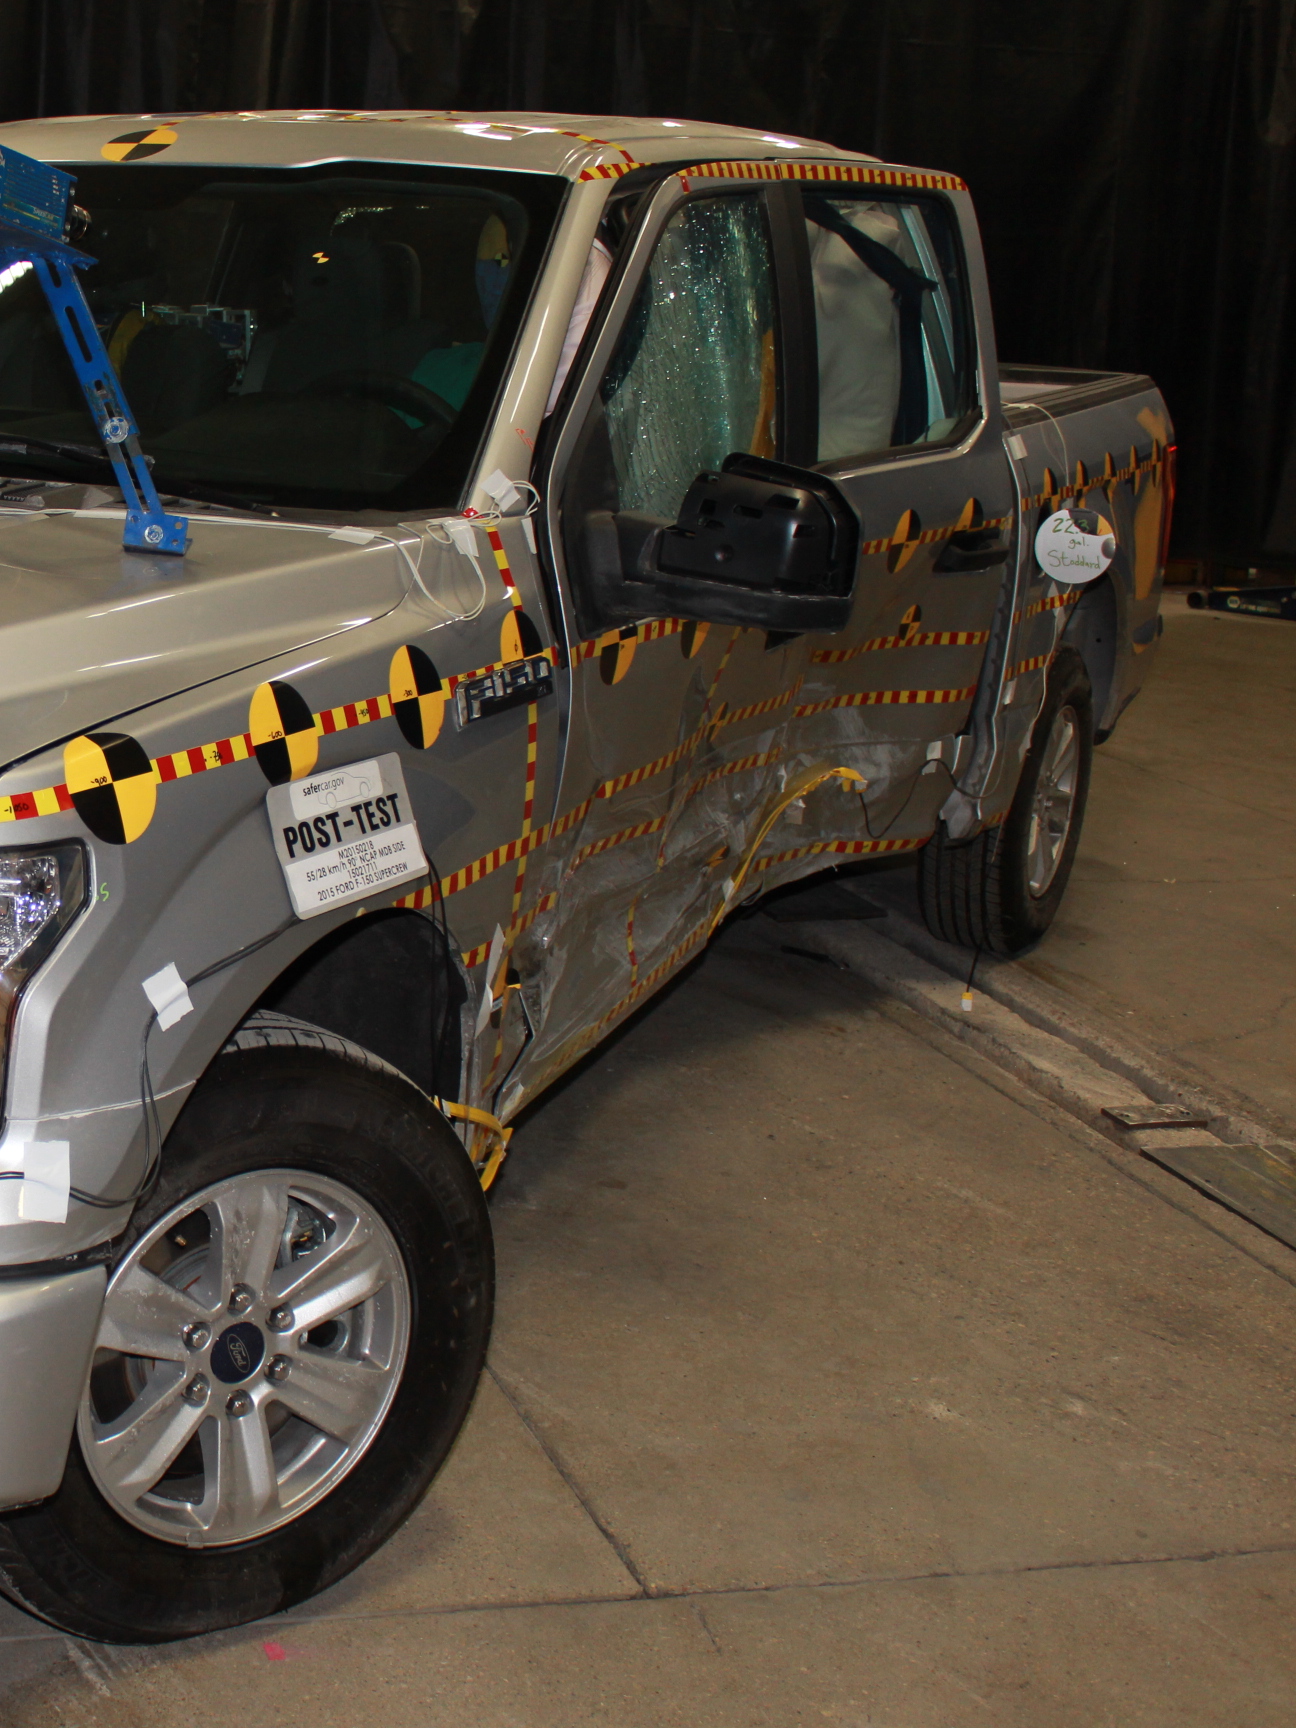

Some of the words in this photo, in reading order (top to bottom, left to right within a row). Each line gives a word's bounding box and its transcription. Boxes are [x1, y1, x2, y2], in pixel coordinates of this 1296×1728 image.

[1052, 517, 1090, 534] 22.3
[1068, 537, 1089, 549] gal.
[1047, 549, 1101, 569] Stoddard
[302, 776, 345, 796] safercar.gov
[282, 793, 401, 858] POST-TEST
[338, 840, 374, 860] M20150218
[306, 866, 327, 882] 55/28
[327, 861, 347, 874] km/h
[359, 850, 377, 863] NCAP
[378, 845, 393, 857] MDB
[392, 841, 406, 853] SIDE
[347, 861, 378, 879] 15021711
[317, 887, 335, 901] 2015
[335, 881, 354, 895] FORD
[355, 873, 375, 888] F-150
[374, 861, 409, 881] SUPERCREW
[229, 1341, 247, 1367] Ford
